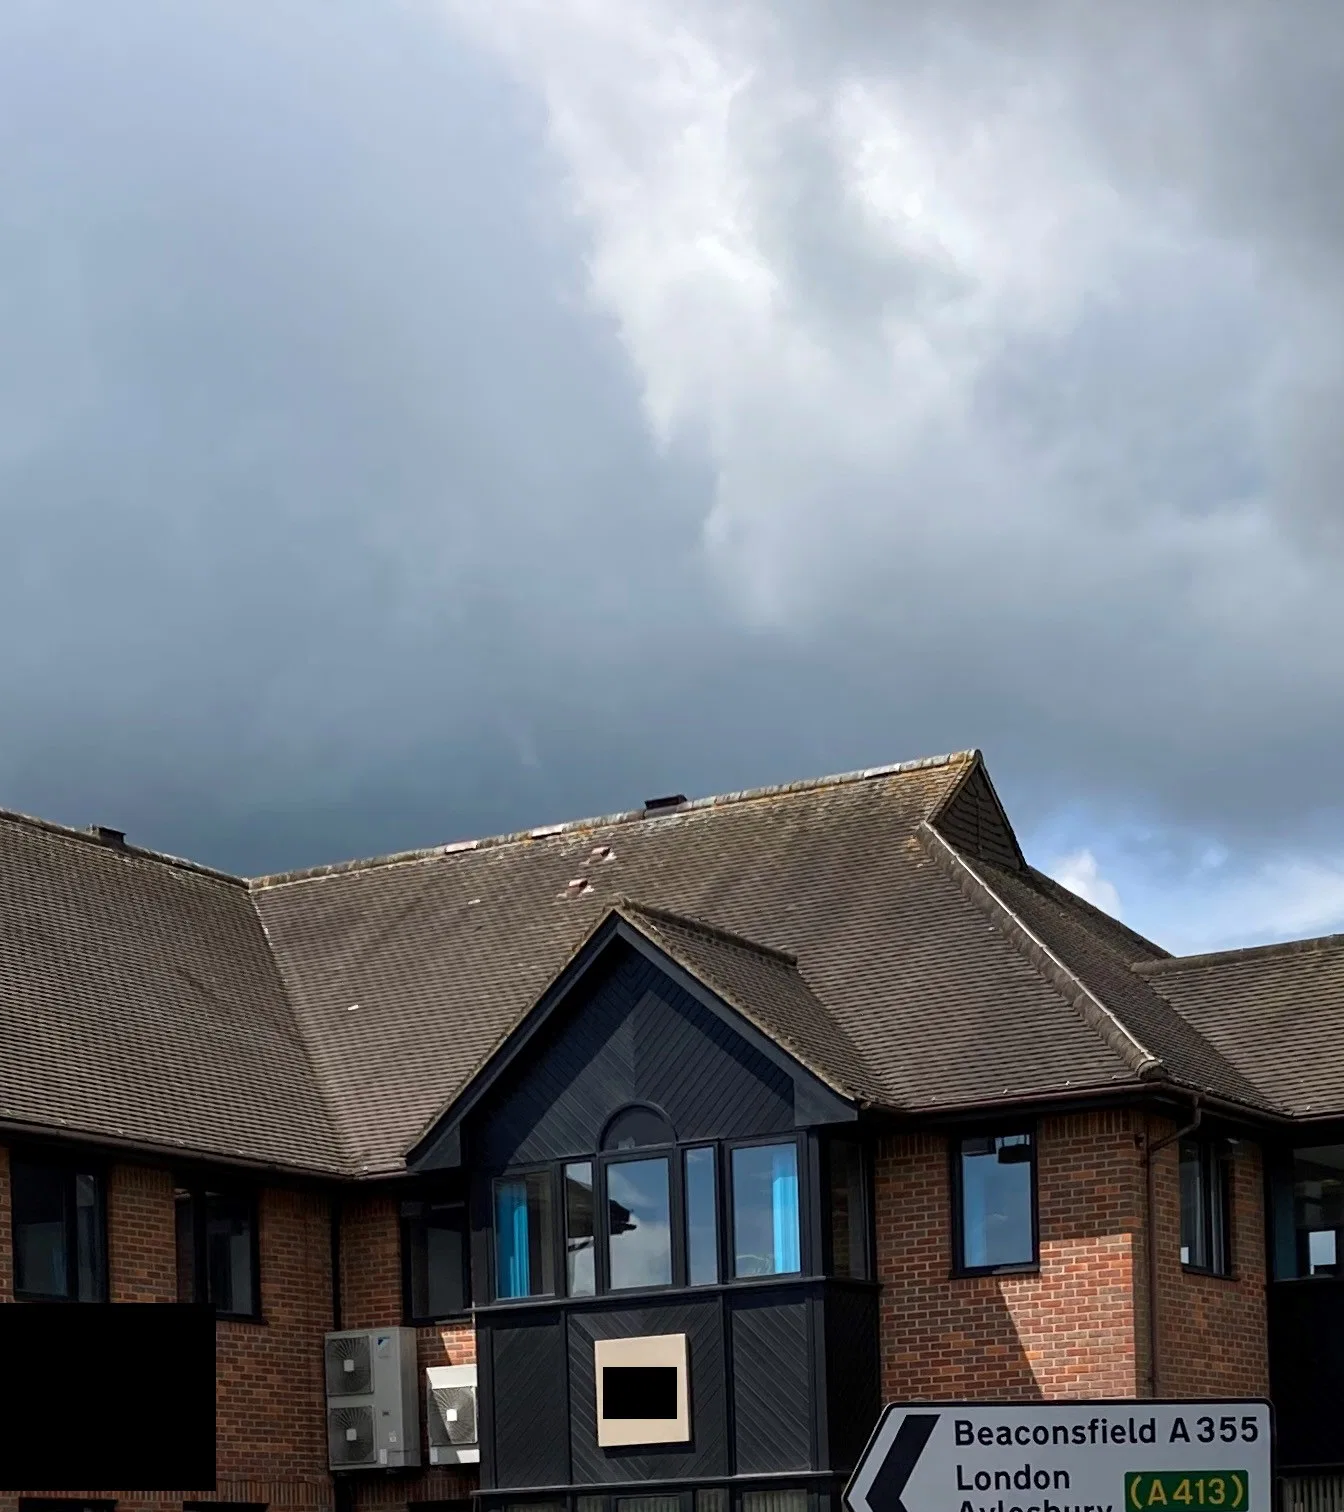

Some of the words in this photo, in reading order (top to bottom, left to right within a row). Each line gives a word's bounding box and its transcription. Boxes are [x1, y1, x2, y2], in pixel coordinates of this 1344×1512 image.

[954, 1417, 1156, 1446] Beaconsfield
[1169, 1416, 1258, 1444] A355
[956, 1464, 1070, 1491] London
[1130, 1474, 1244, 1509] (A413)
